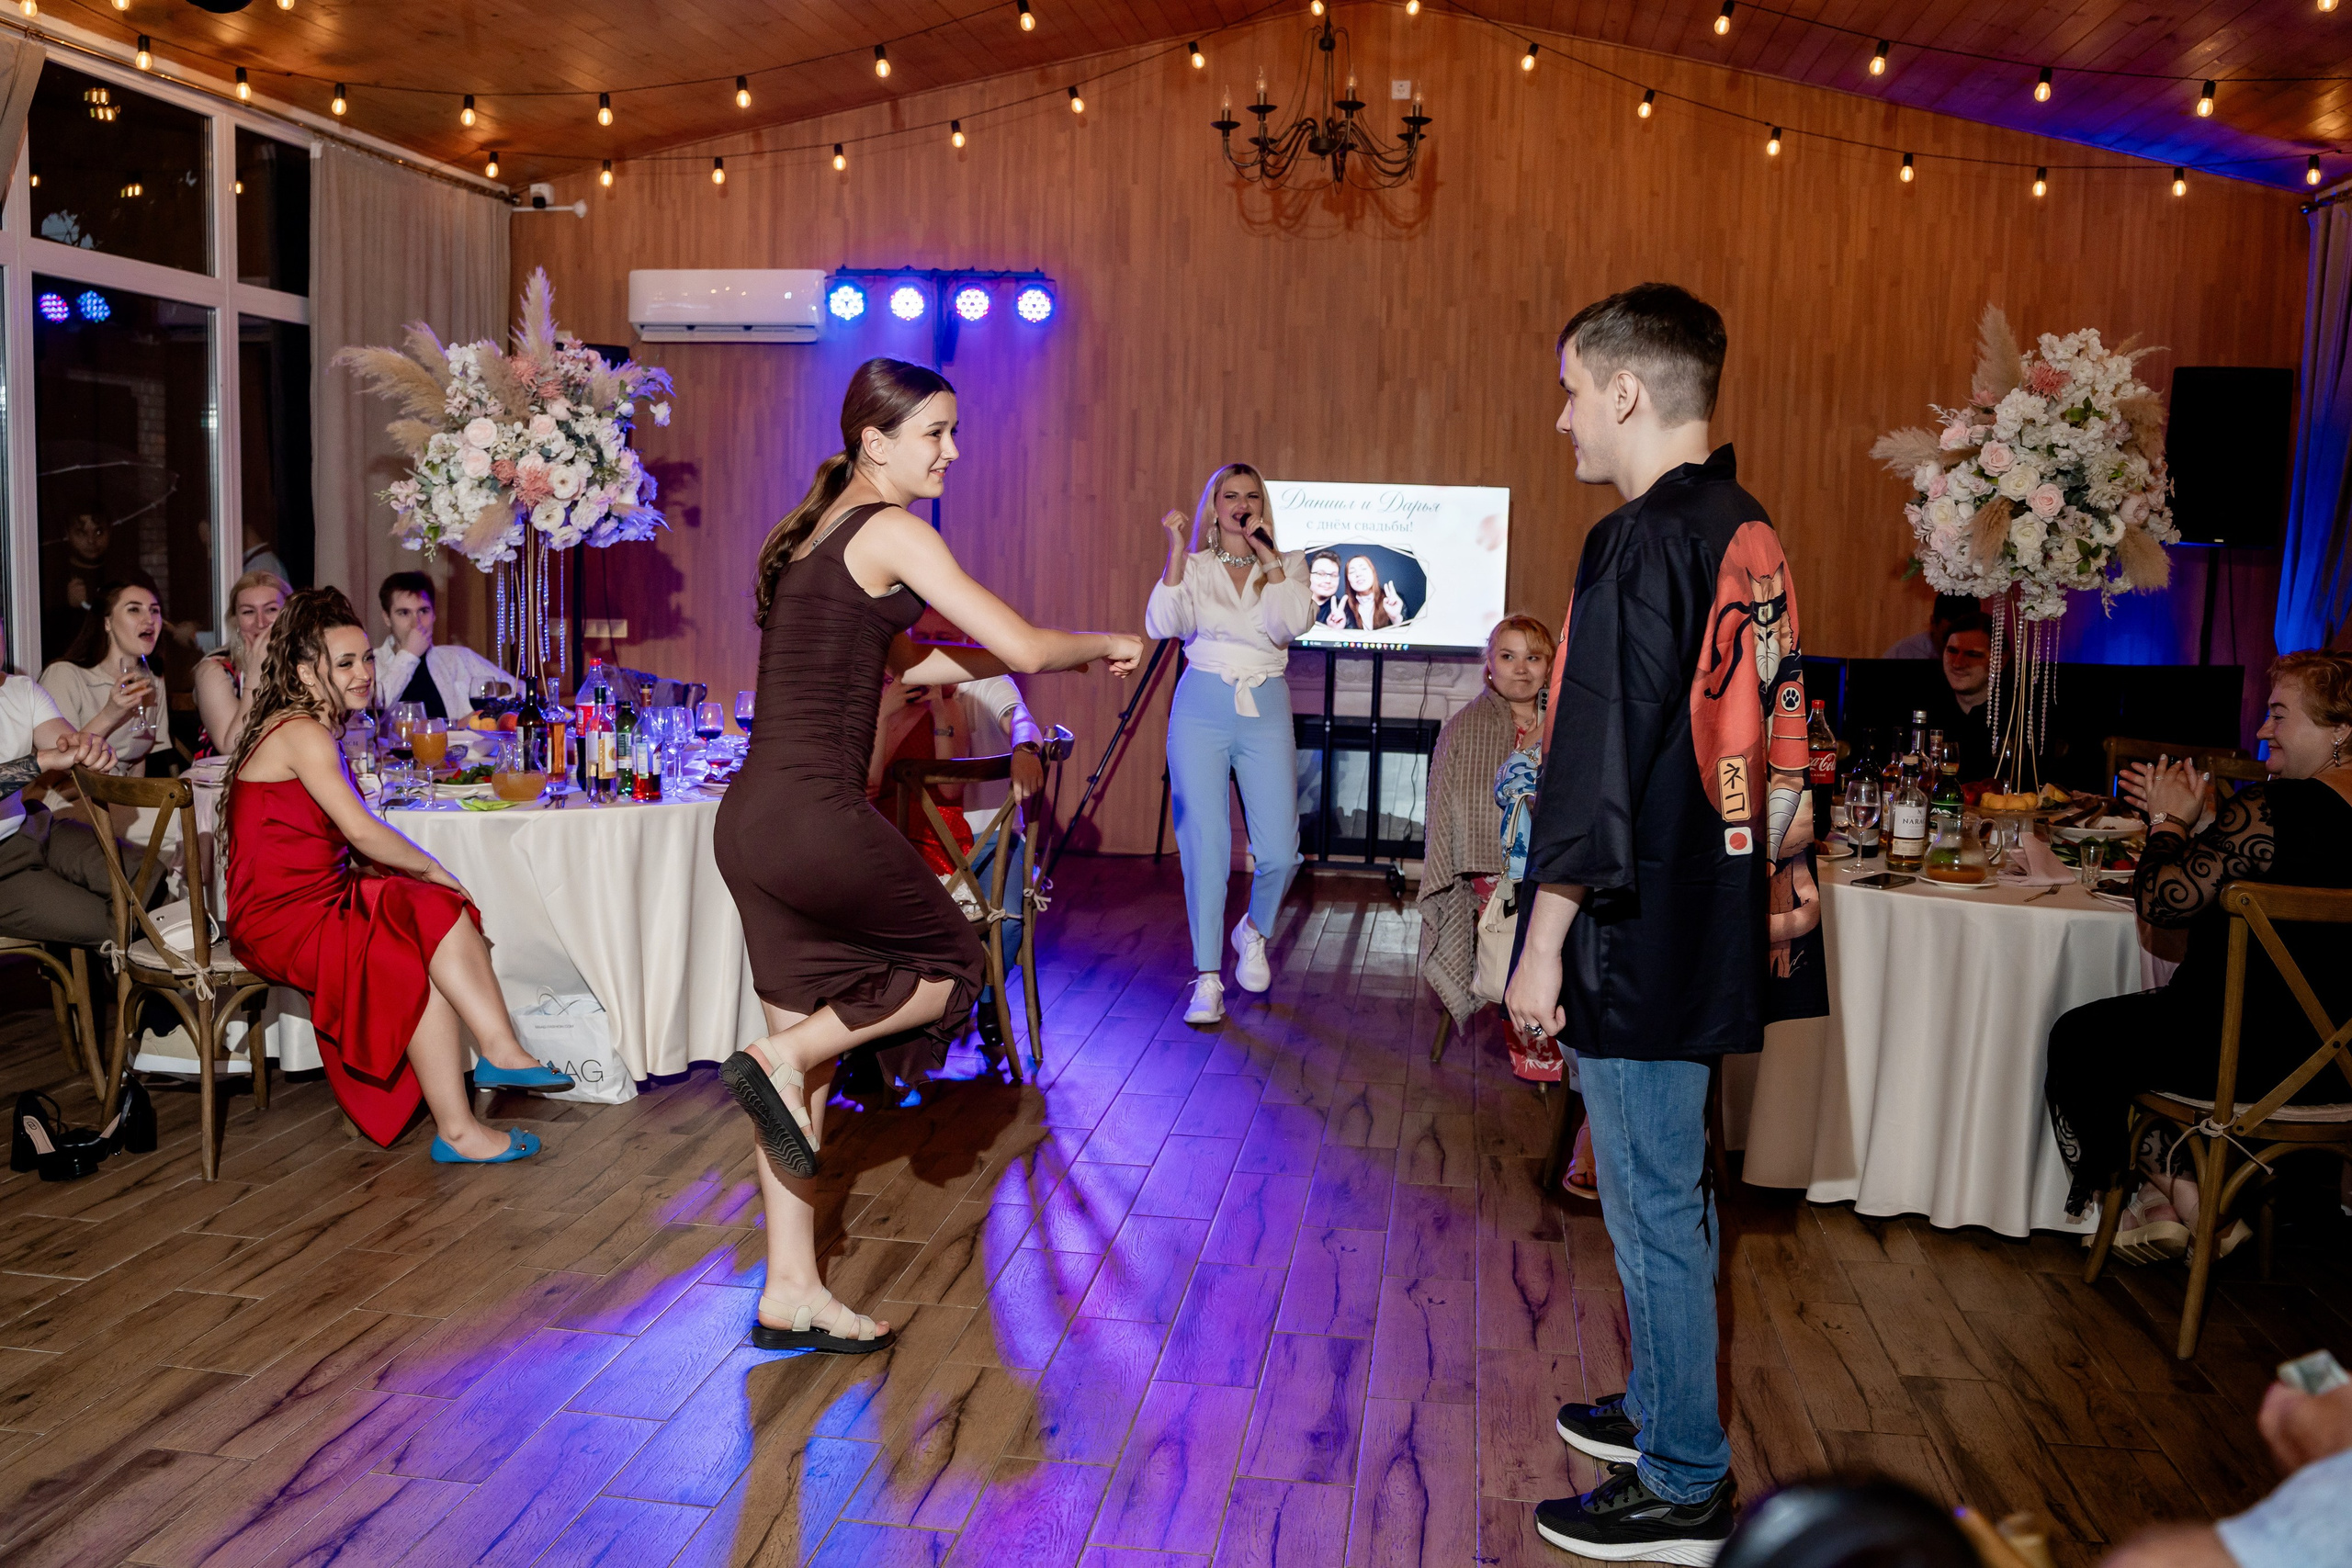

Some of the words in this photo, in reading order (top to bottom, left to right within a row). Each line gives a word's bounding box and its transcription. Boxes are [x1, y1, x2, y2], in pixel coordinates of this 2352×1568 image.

[1279, 488, 1355, 510] Даниил
[1361, 500, 1372, 510] и
[1378, 490, 1442, 519] Дарья
[1306, 521, 1314, 530] с
[1317, 519, 1351, 531] днём
[1354, 521, 1414, 533] свадьбы!
[1724, 763, 1745, 814] ネコ
[537, 1060, 604, 1082] AG
